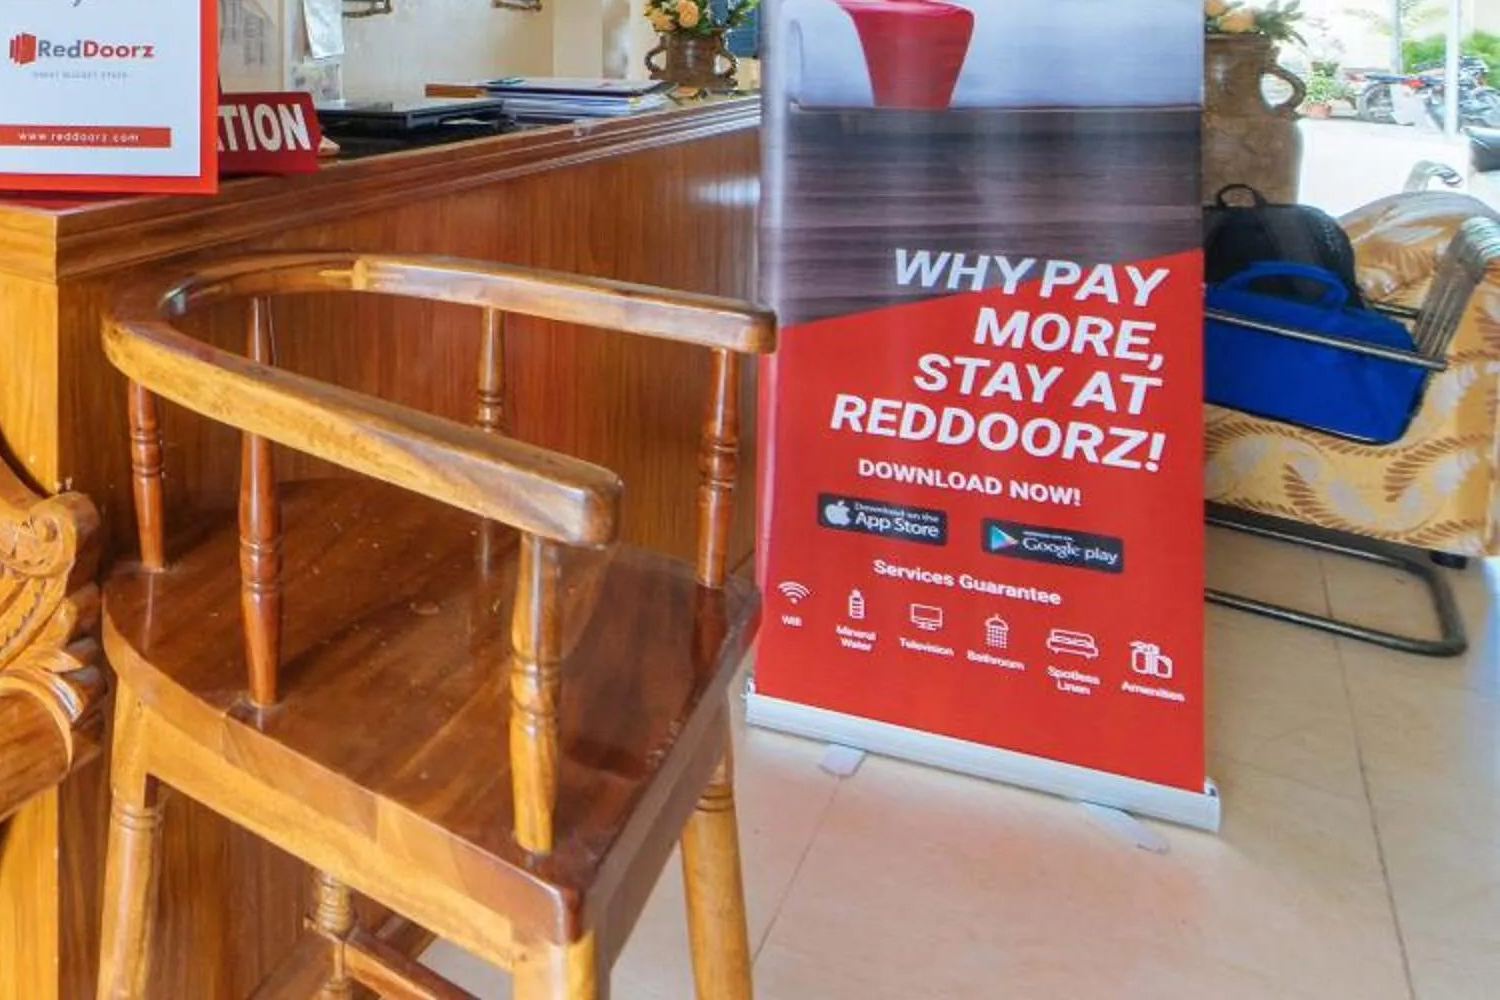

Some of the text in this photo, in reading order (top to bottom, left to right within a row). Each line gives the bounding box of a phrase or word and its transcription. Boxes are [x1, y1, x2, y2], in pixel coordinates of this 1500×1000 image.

[38, 40, 155, 58] RedDoorz
[217, 103, 312, 152] TION
[894, 249, 1170, 307] WHY PAY
[973, 307, 1165, 371] MORE,
[913, 353, 1163, 416] STAY AT
[830, 393, 1166, 472] REDDOORZ!
[858, 458, 1081, 506] DOWNLOAD NOW!
[855, 512, 940, 537] App Store
[1022, 537, 1118, 566] Google play
[873, 559, 1062, 605] Services Guarantee
[835, 625, 877, 641] Mineral
[840, 638, 872, 652] Water
[899, 637, 955, 657] Television
[966, 649, 1026, 671] Bathroom
[1047, 665, 1101, 685] Spotless
[1057, 680, 1091, 695] Linen
[1121, 681, 1186, 702] Amenities
